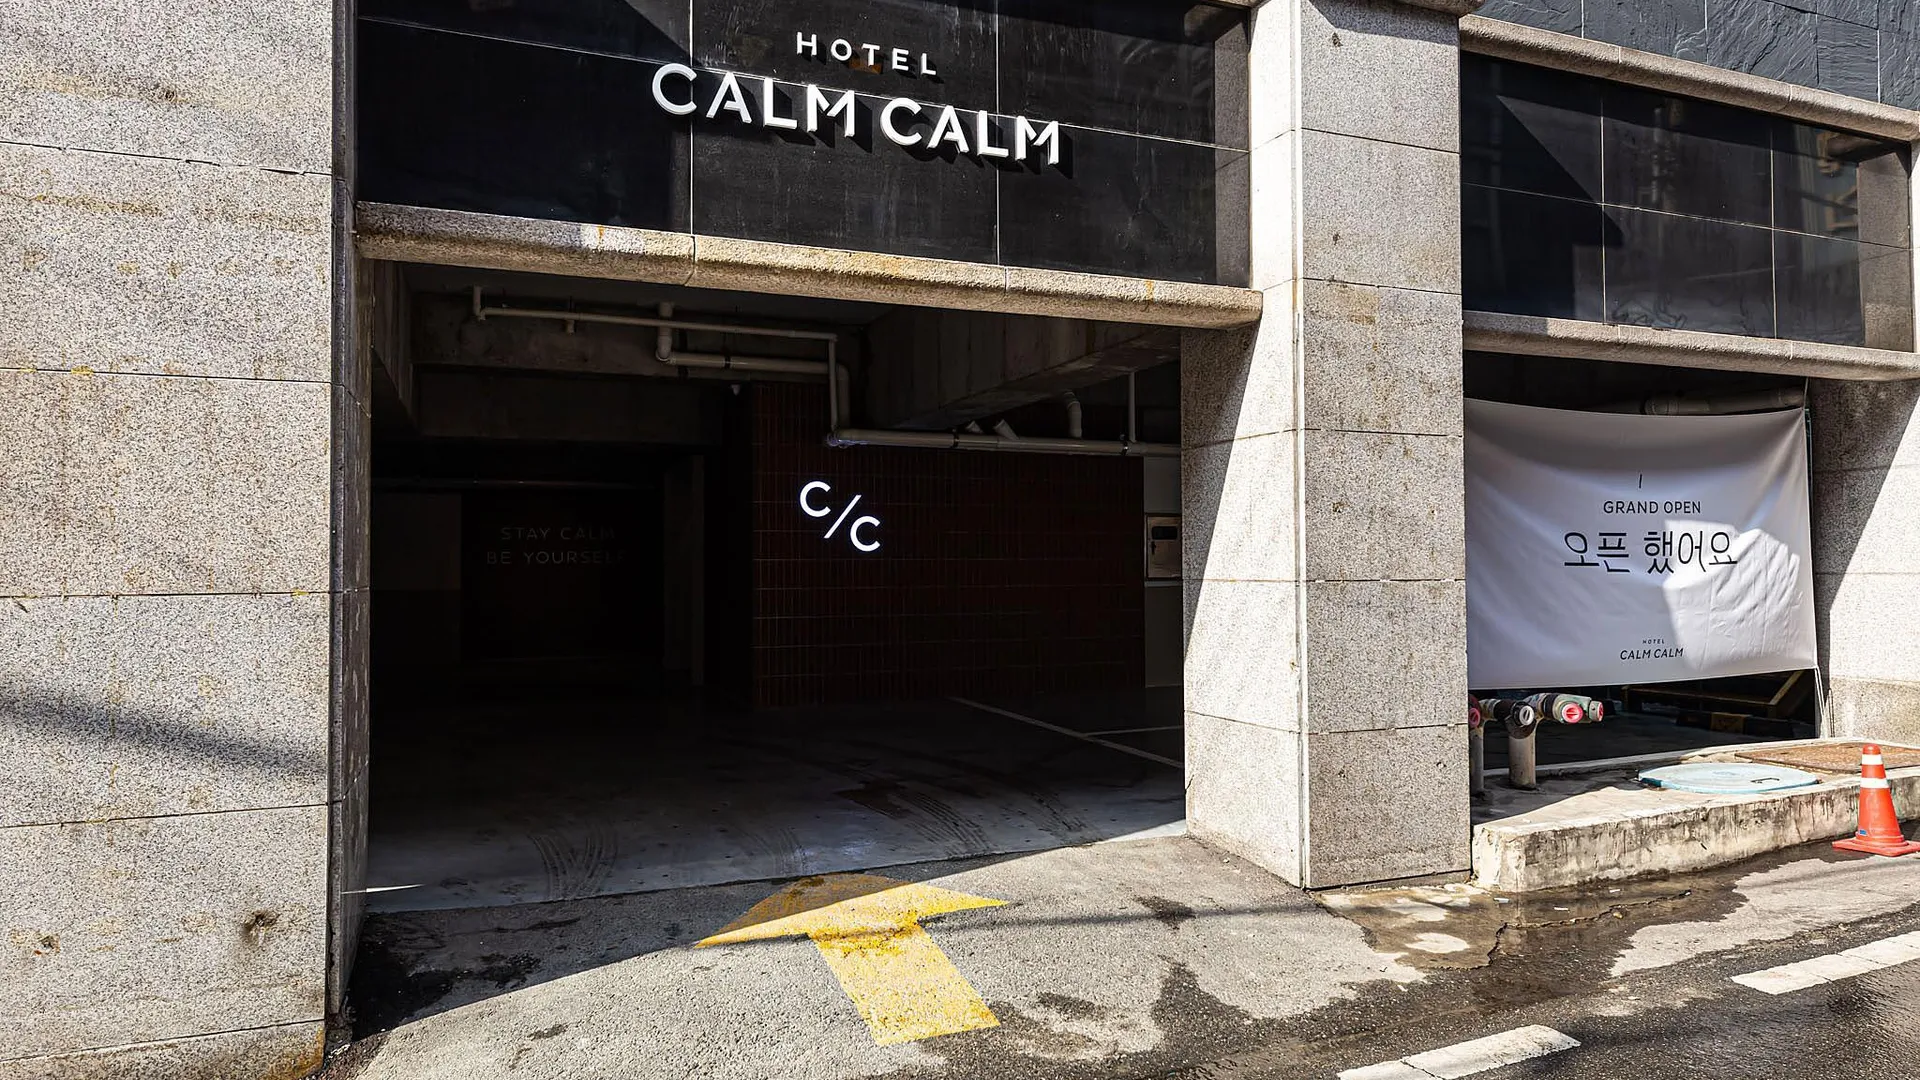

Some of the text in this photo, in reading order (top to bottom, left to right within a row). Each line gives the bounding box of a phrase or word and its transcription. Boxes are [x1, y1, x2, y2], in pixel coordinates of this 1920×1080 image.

[796, 31, 937, 76] HOTEL
[651, 62, 1060, 165] CALM CALM
[799, 480, 881, 552] C/C
[1603, 500, 1701, 514] GRAND OPEN
[500, 525, 616, 541] STAY CALM
[486, 549, 627, 565] BE YOURSELF
[1563, 530, 1738, 574] 오픈 했어요
[1620, 647, 1684, 660] CALM CALM
